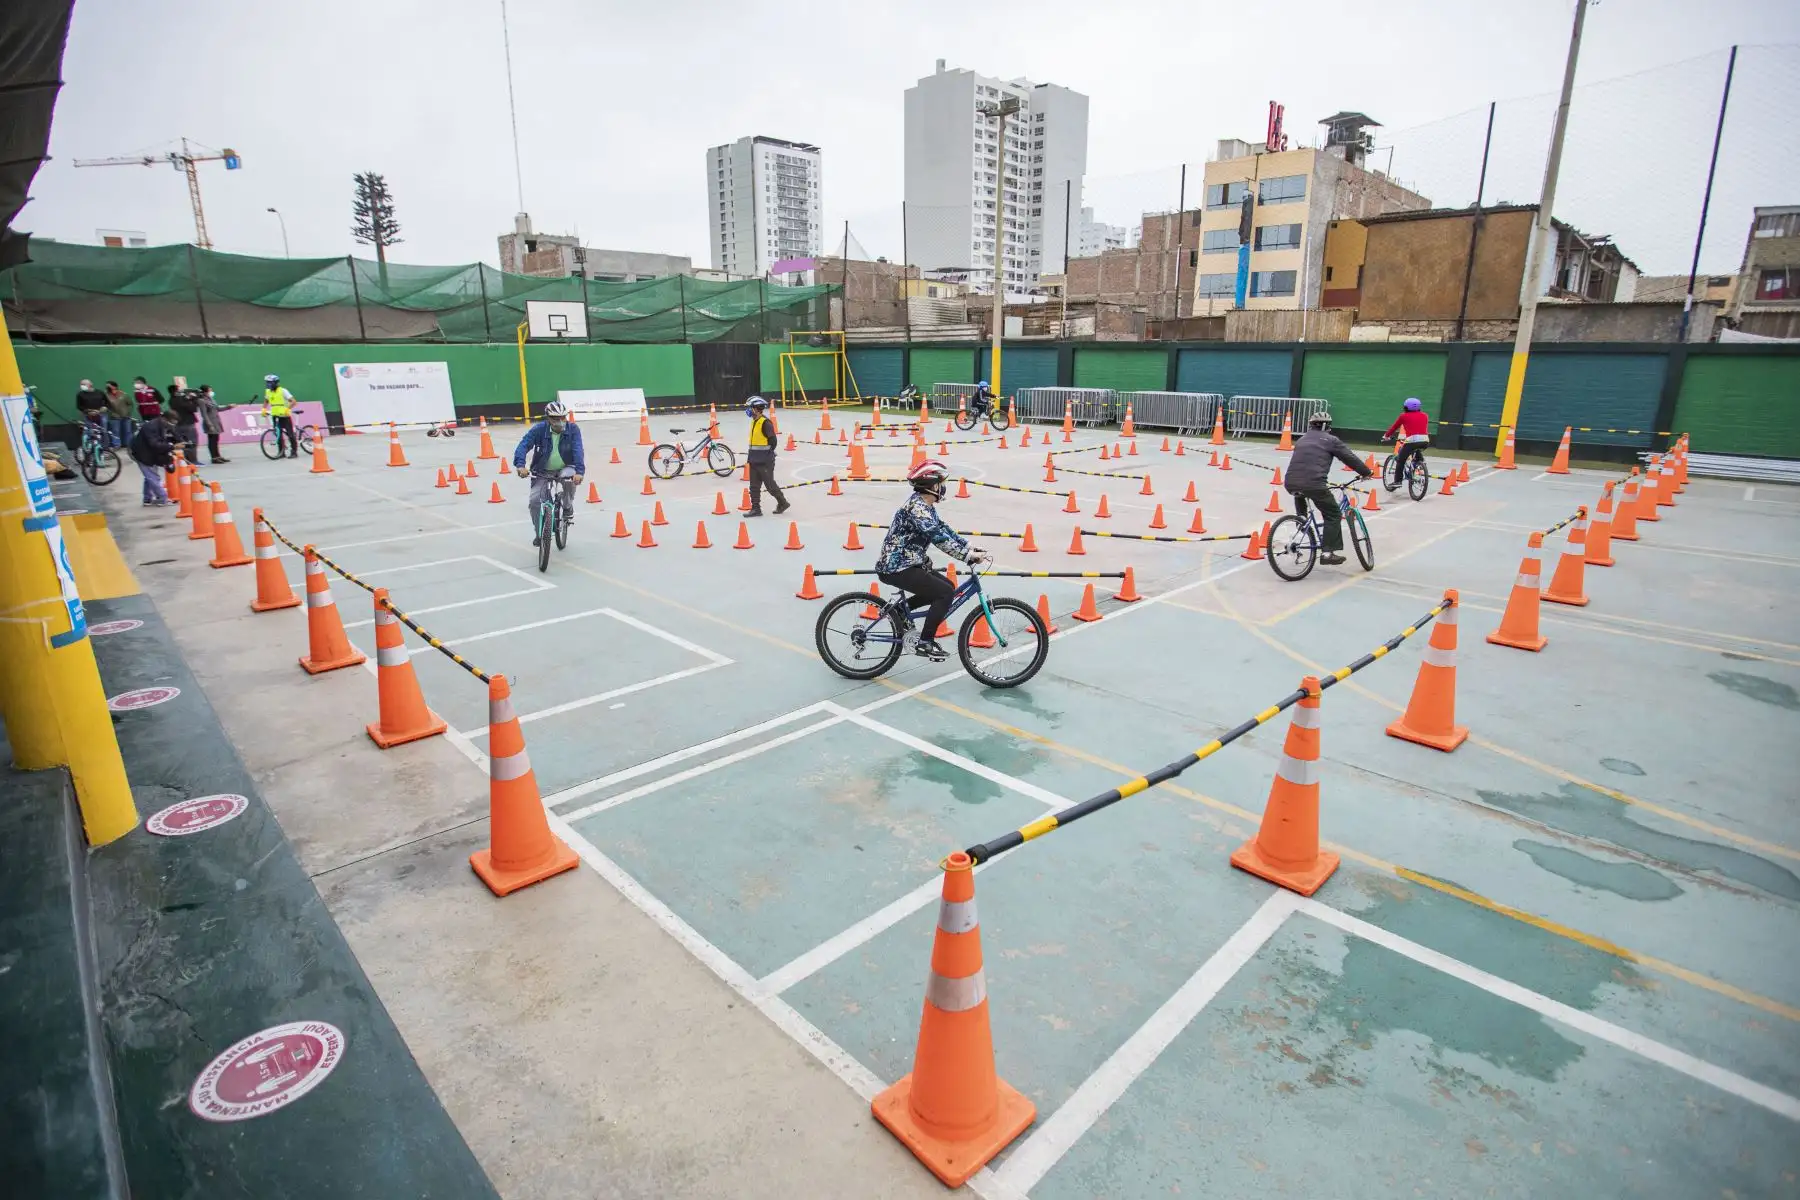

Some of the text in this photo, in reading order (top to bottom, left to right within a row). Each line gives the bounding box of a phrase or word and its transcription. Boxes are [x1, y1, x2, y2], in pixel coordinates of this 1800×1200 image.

[199, 1035, 289, 1116] MANTENGA SU DISTANCIA
[320, 1034, 339, 1069] ESPERE
